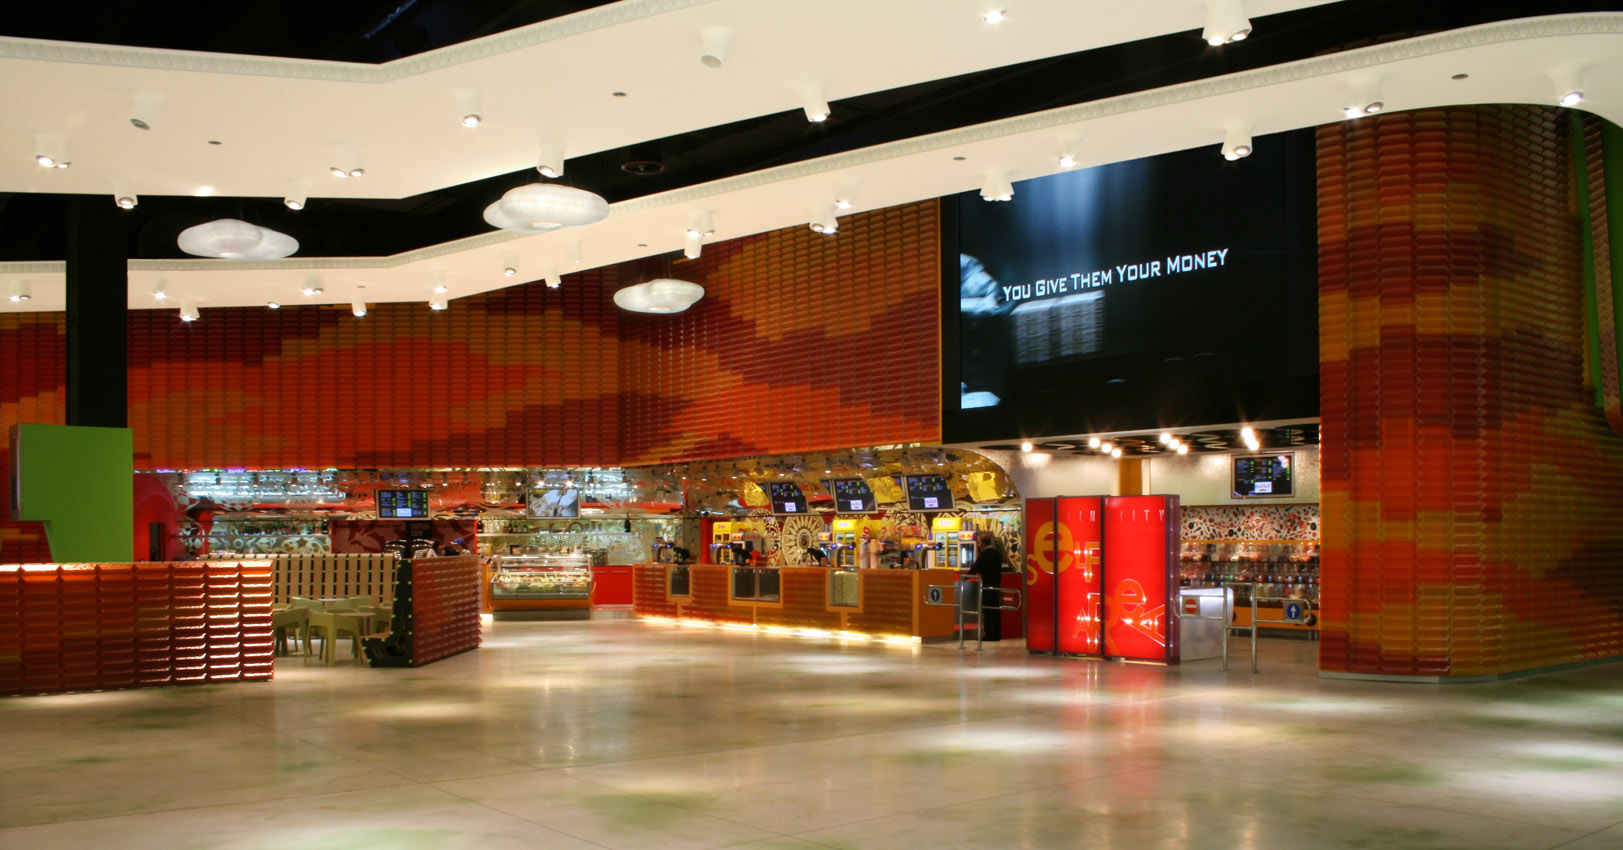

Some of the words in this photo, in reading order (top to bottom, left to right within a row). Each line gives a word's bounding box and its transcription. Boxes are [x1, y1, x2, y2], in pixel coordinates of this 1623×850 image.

[1003, 285, 1031, 302] YOU
[1036, 277, 1067, 297] GIVE
[1071, 269, 1112, 291] THEM
[1116, 260, 1161, 283] YOUR
[1167, 248, 1229, 275] MONEY
